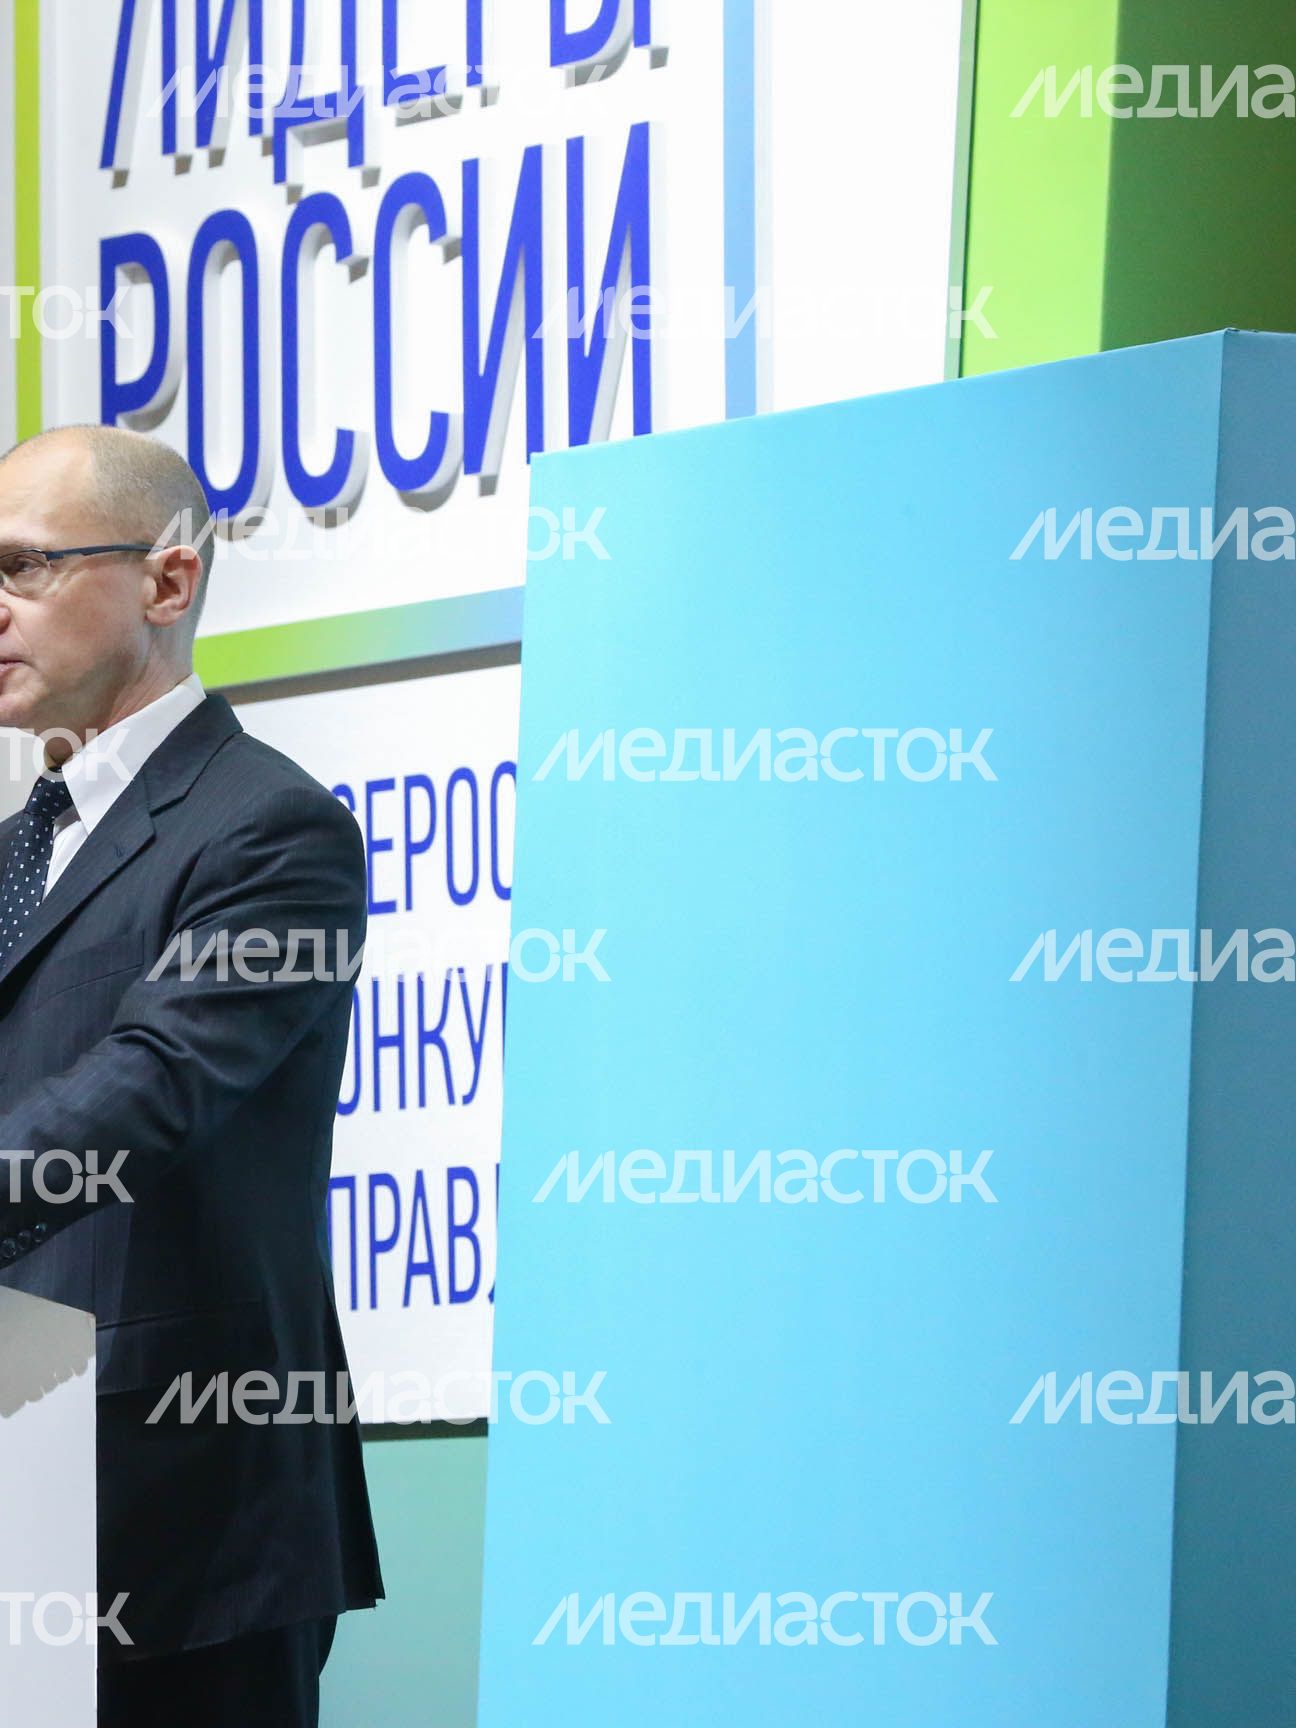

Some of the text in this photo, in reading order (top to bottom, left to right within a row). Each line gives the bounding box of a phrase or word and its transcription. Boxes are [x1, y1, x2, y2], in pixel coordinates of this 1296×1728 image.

[100, 0, 653, 186] ЛИД
[100, 122, 652, 521] РОССИИ
[331, 761, 517, 916] ЕРОС
[336, 963, 508, 1116] ОНКУ
[327, 1163, 500, 1312] ПРАВ
